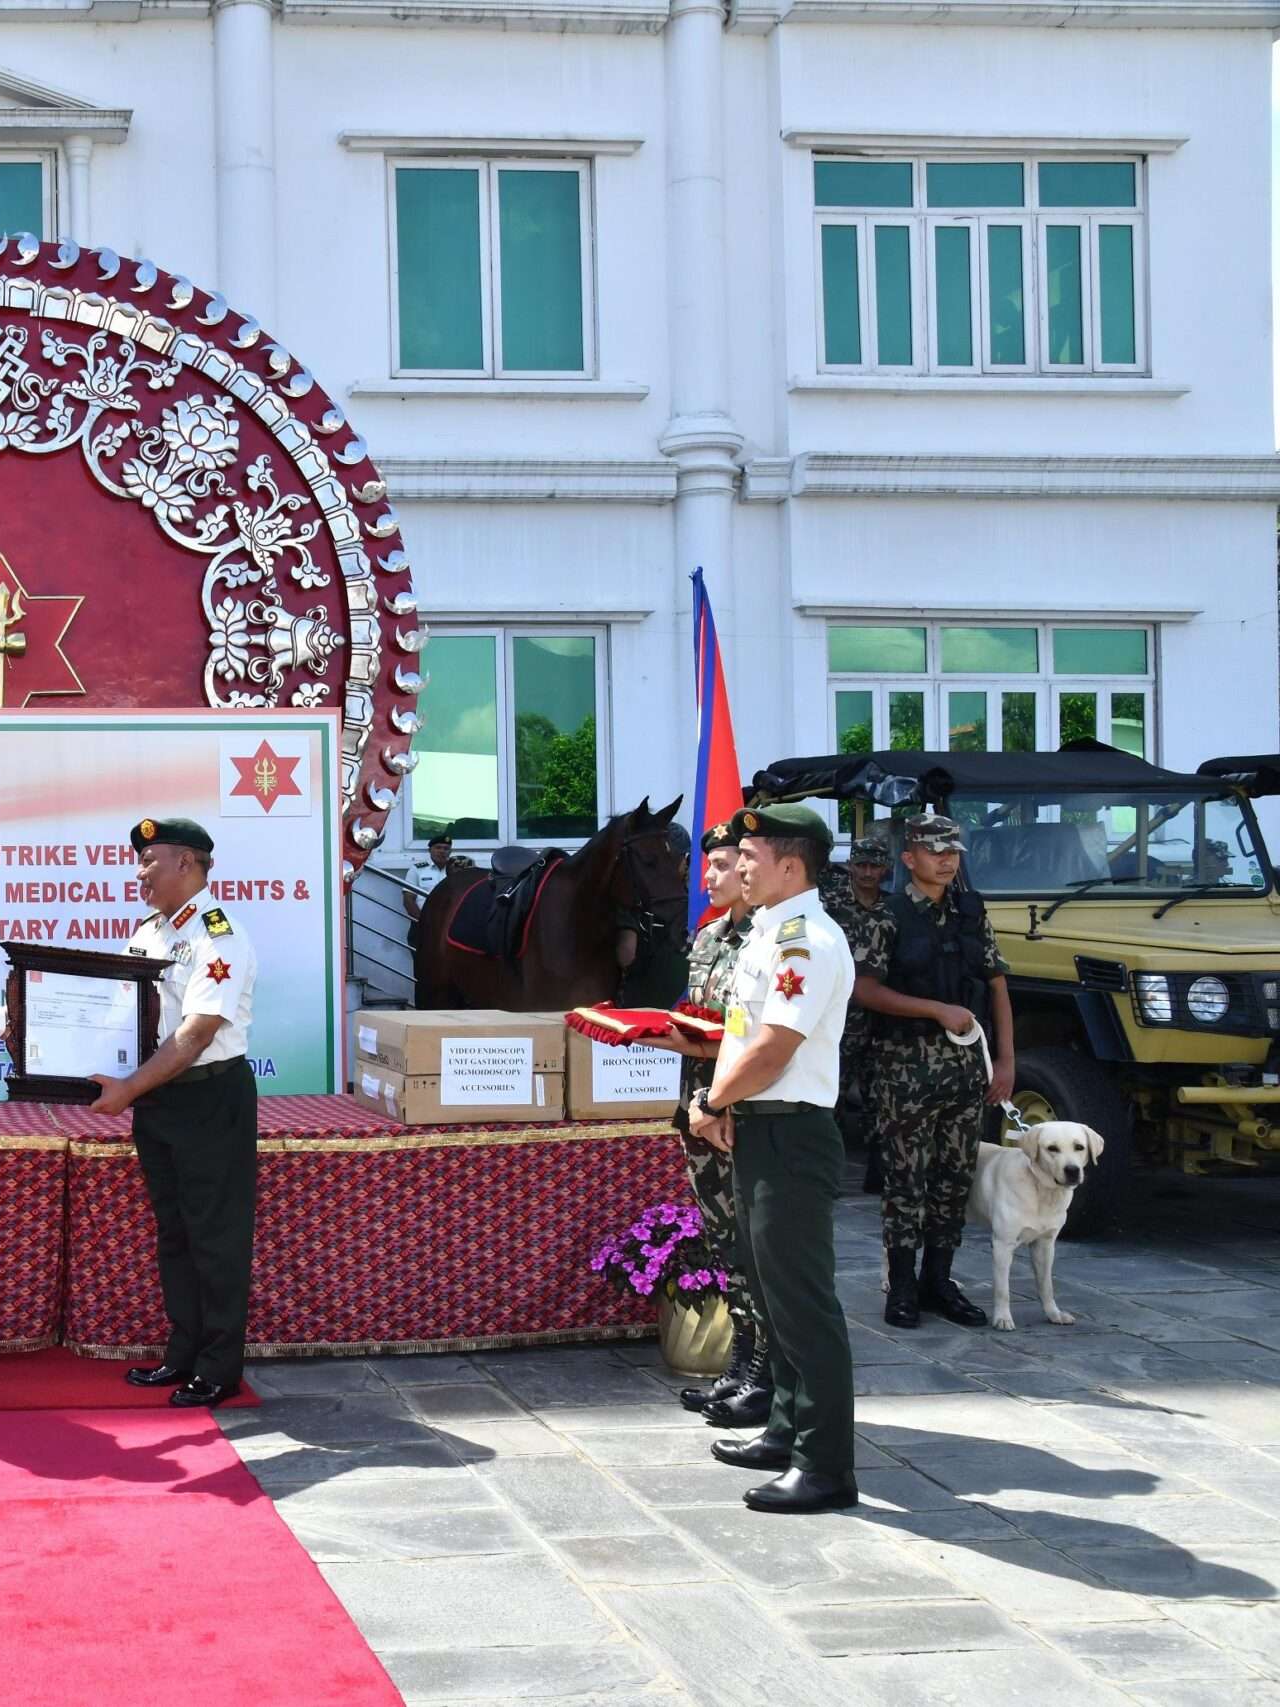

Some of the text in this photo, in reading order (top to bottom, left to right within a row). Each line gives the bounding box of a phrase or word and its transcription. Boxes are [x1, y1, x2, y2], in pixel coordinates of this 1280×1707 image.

[5, 881, 115, 903] MEDICAL
[294, 879, 310, 900] &
[450, 1047, 526, 1055] VIDEO ENDOSCOPY
[626, 1045, 655, 1054] VIDEO
[602, 1057, 678, 1066] BRONCHOSCOPE
[453, 1068, 521, 1076] SIGMOIDOSCOPY
[629, 1070, 651, 1078] UNIT
[460, 1084, 515, 1092] ACCESSORIES
[613, 1086, 669, 1094] ACCESSORIES
